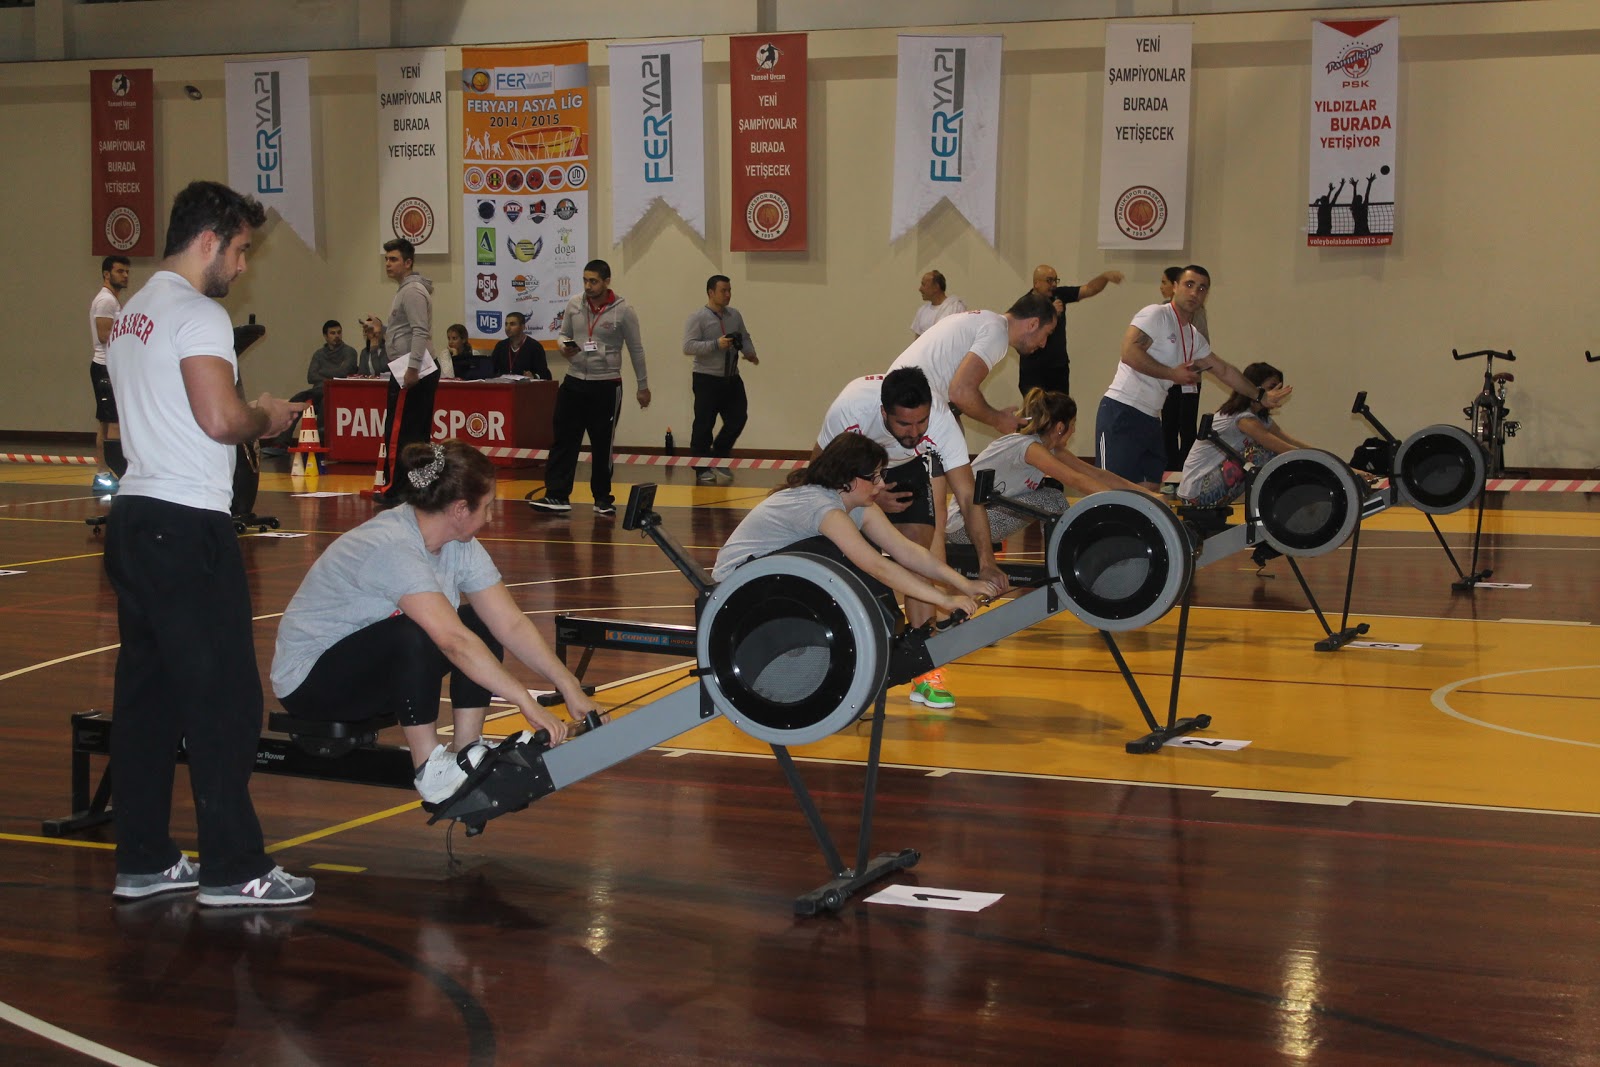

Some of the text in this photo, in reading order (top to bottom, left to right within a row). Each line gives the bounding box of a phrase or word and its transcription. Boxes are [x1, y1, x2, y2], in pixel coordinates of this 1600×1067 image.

[1136, 35, 1160, 53] YENİ
[401, 63, 420, 79] YENİ
[1108, 64, 1185, 85] ŞAMPİYONLAR
[496, 71, 552, 90] FERYAPI
[1342, 80, 1369, 89] PSK
[380, 91, 442, 108] ŞAMPİYONLAR
[467, 93, 583, 113] FERYAPI ASYA LİG
[759, 92, 777, 107] YENİ
[1123, 97, 1168, 111] BURADA
[1315, 99, 1377, 113] YILDIZLAR
[114, 117, 129, 130] YENİ
[490, 115, 518, 127] 2014
[531, 114, 560, 126] 2015
[641, 54, 673, 183] FERYAPI
[930, 48, 966, 182] FERYAPI
[1330, 115, 1391, 132] BURADA
[254, 71, 283, 193] FERYAPI
[393, 118, 430, 132] BURADA
[738, 116, 797, 133] ŞAMPİYONLAR
[1115, 123, 1174, 143] YETİŞECEK
[98, 139, 145, 154] ŞAMPİYONLAR
[750, 141, 785, 153] BURADA
[1320, 134, 1380, 150] YETİŞİYOR
[388, 142, 436, 160] YETİŞECEK
[107, 161, 136, 172] BURADA
[745, 163, 790, 178] YETİŞECEK
[105, 180, 140, 195] YETİŞECEK
[769, 194, 789, 222] BASKETBOL
[1119, 190, 1165, 220] PAMUKSPOR BASKETBOL
[479, 279, 496, 290] BSK
[480, 315, 498, 329] MB
[106, 313, 154, 349] RAINER
[336, 407, 506, 441] PAMSPOR
[241, 878, 272, 899] N
